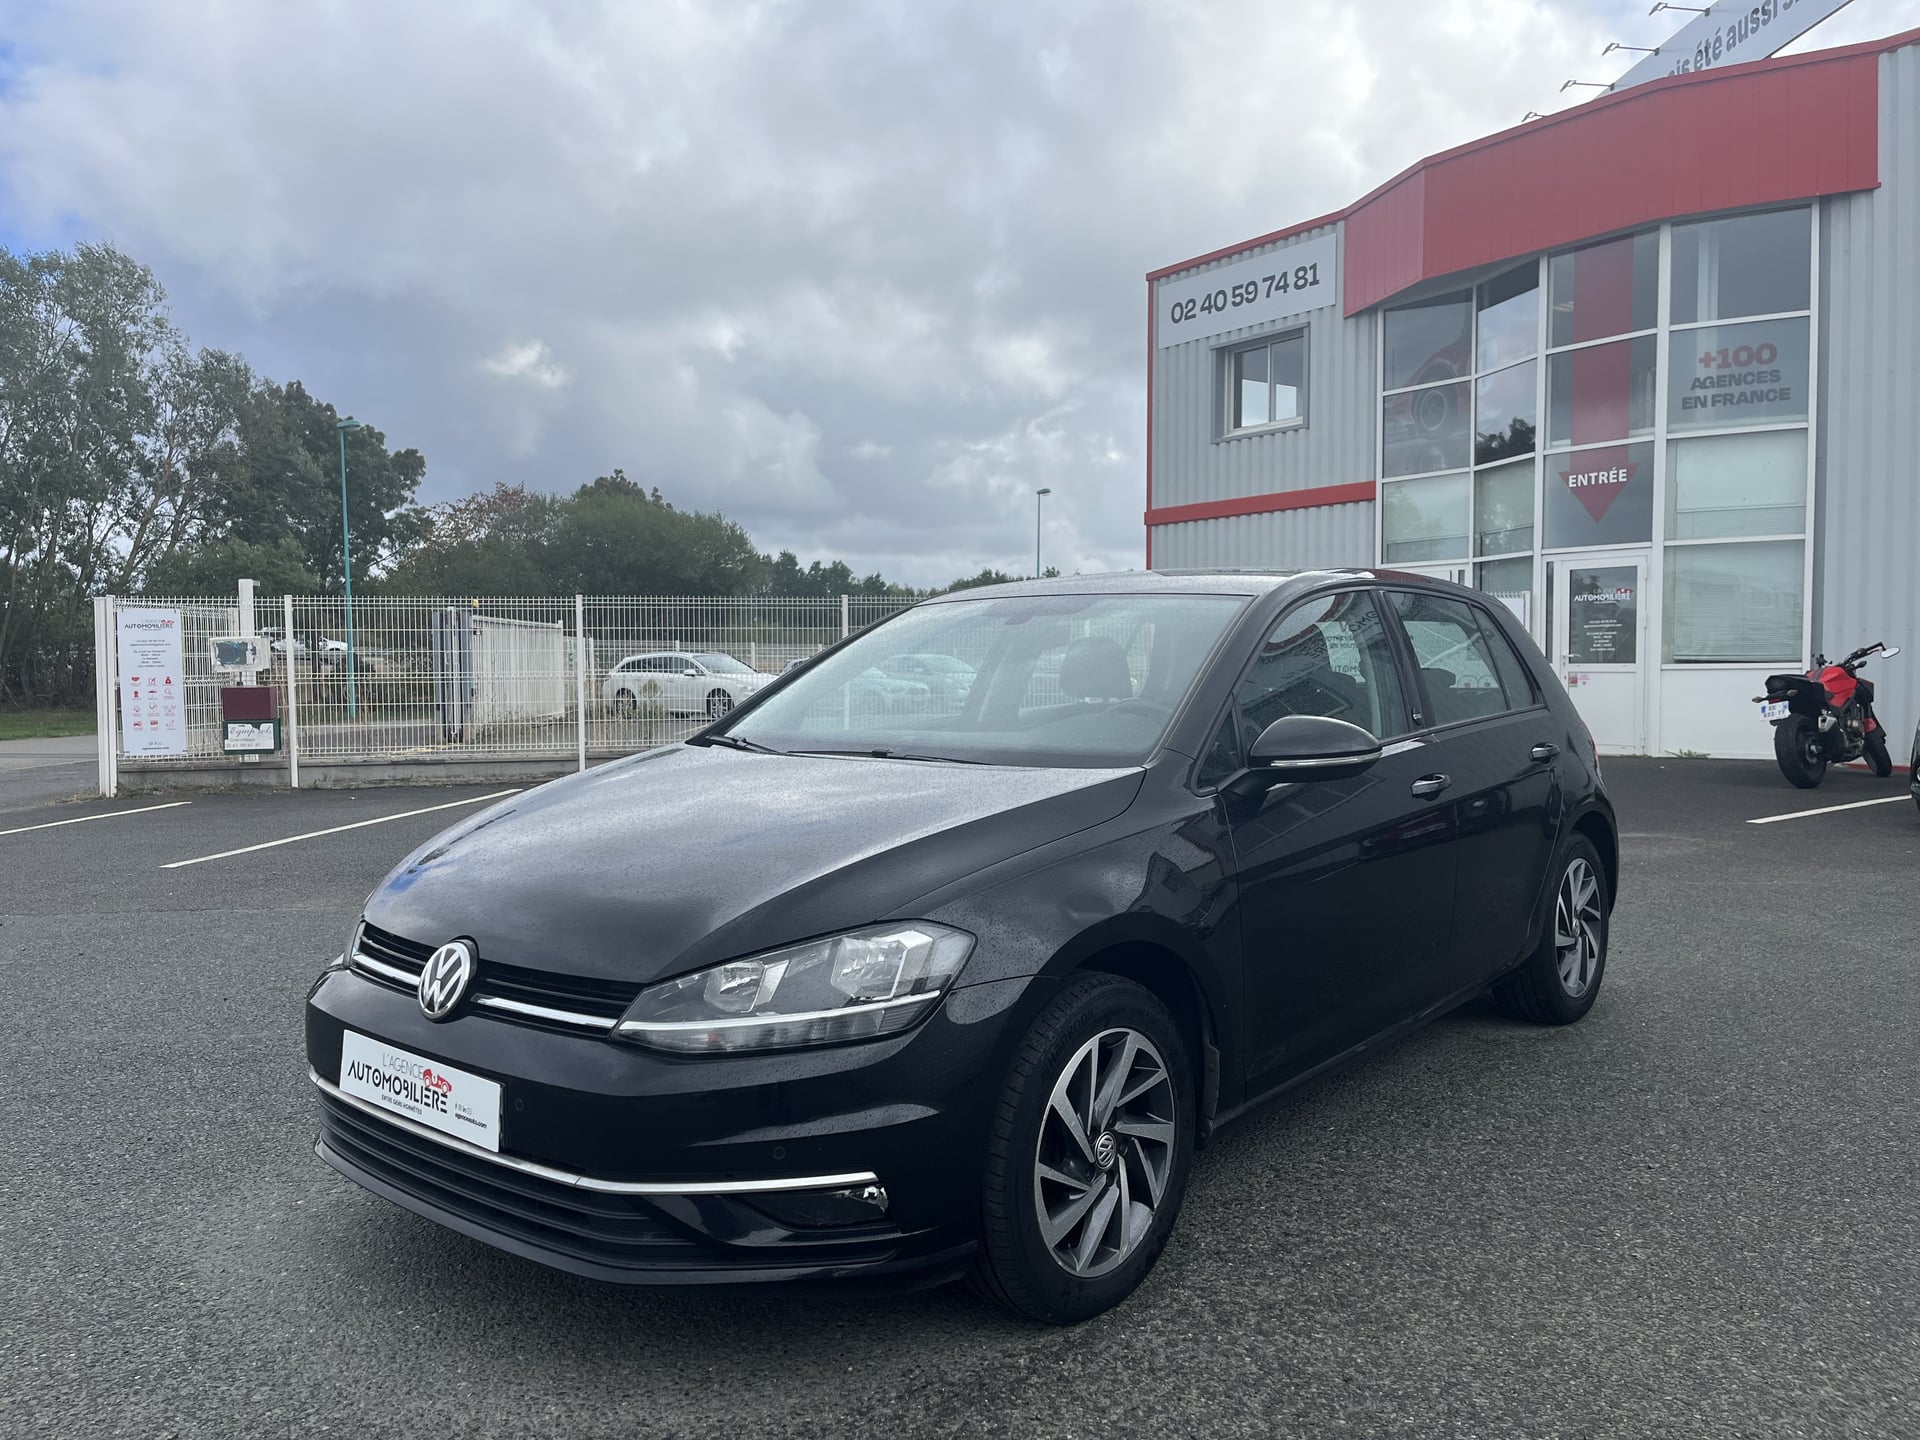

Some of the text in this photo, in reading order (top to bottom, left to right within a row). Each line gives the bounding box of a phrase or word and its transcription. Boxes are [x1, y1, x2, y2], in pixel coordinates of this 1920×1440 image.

[1694, 27, 1722, 71] été
[1171, 263, 1320, 324] 02 40 59 74 81
[1698, 342, 1778, 369] +100
[1690, 369, 1782, 391] AGENCES
[1681, 387, 1791, 410] EN FRANCE
[1568, 467, 1628, 488] ENTRÉE
[382, 1052, 424, 1080] L'AGENCE
